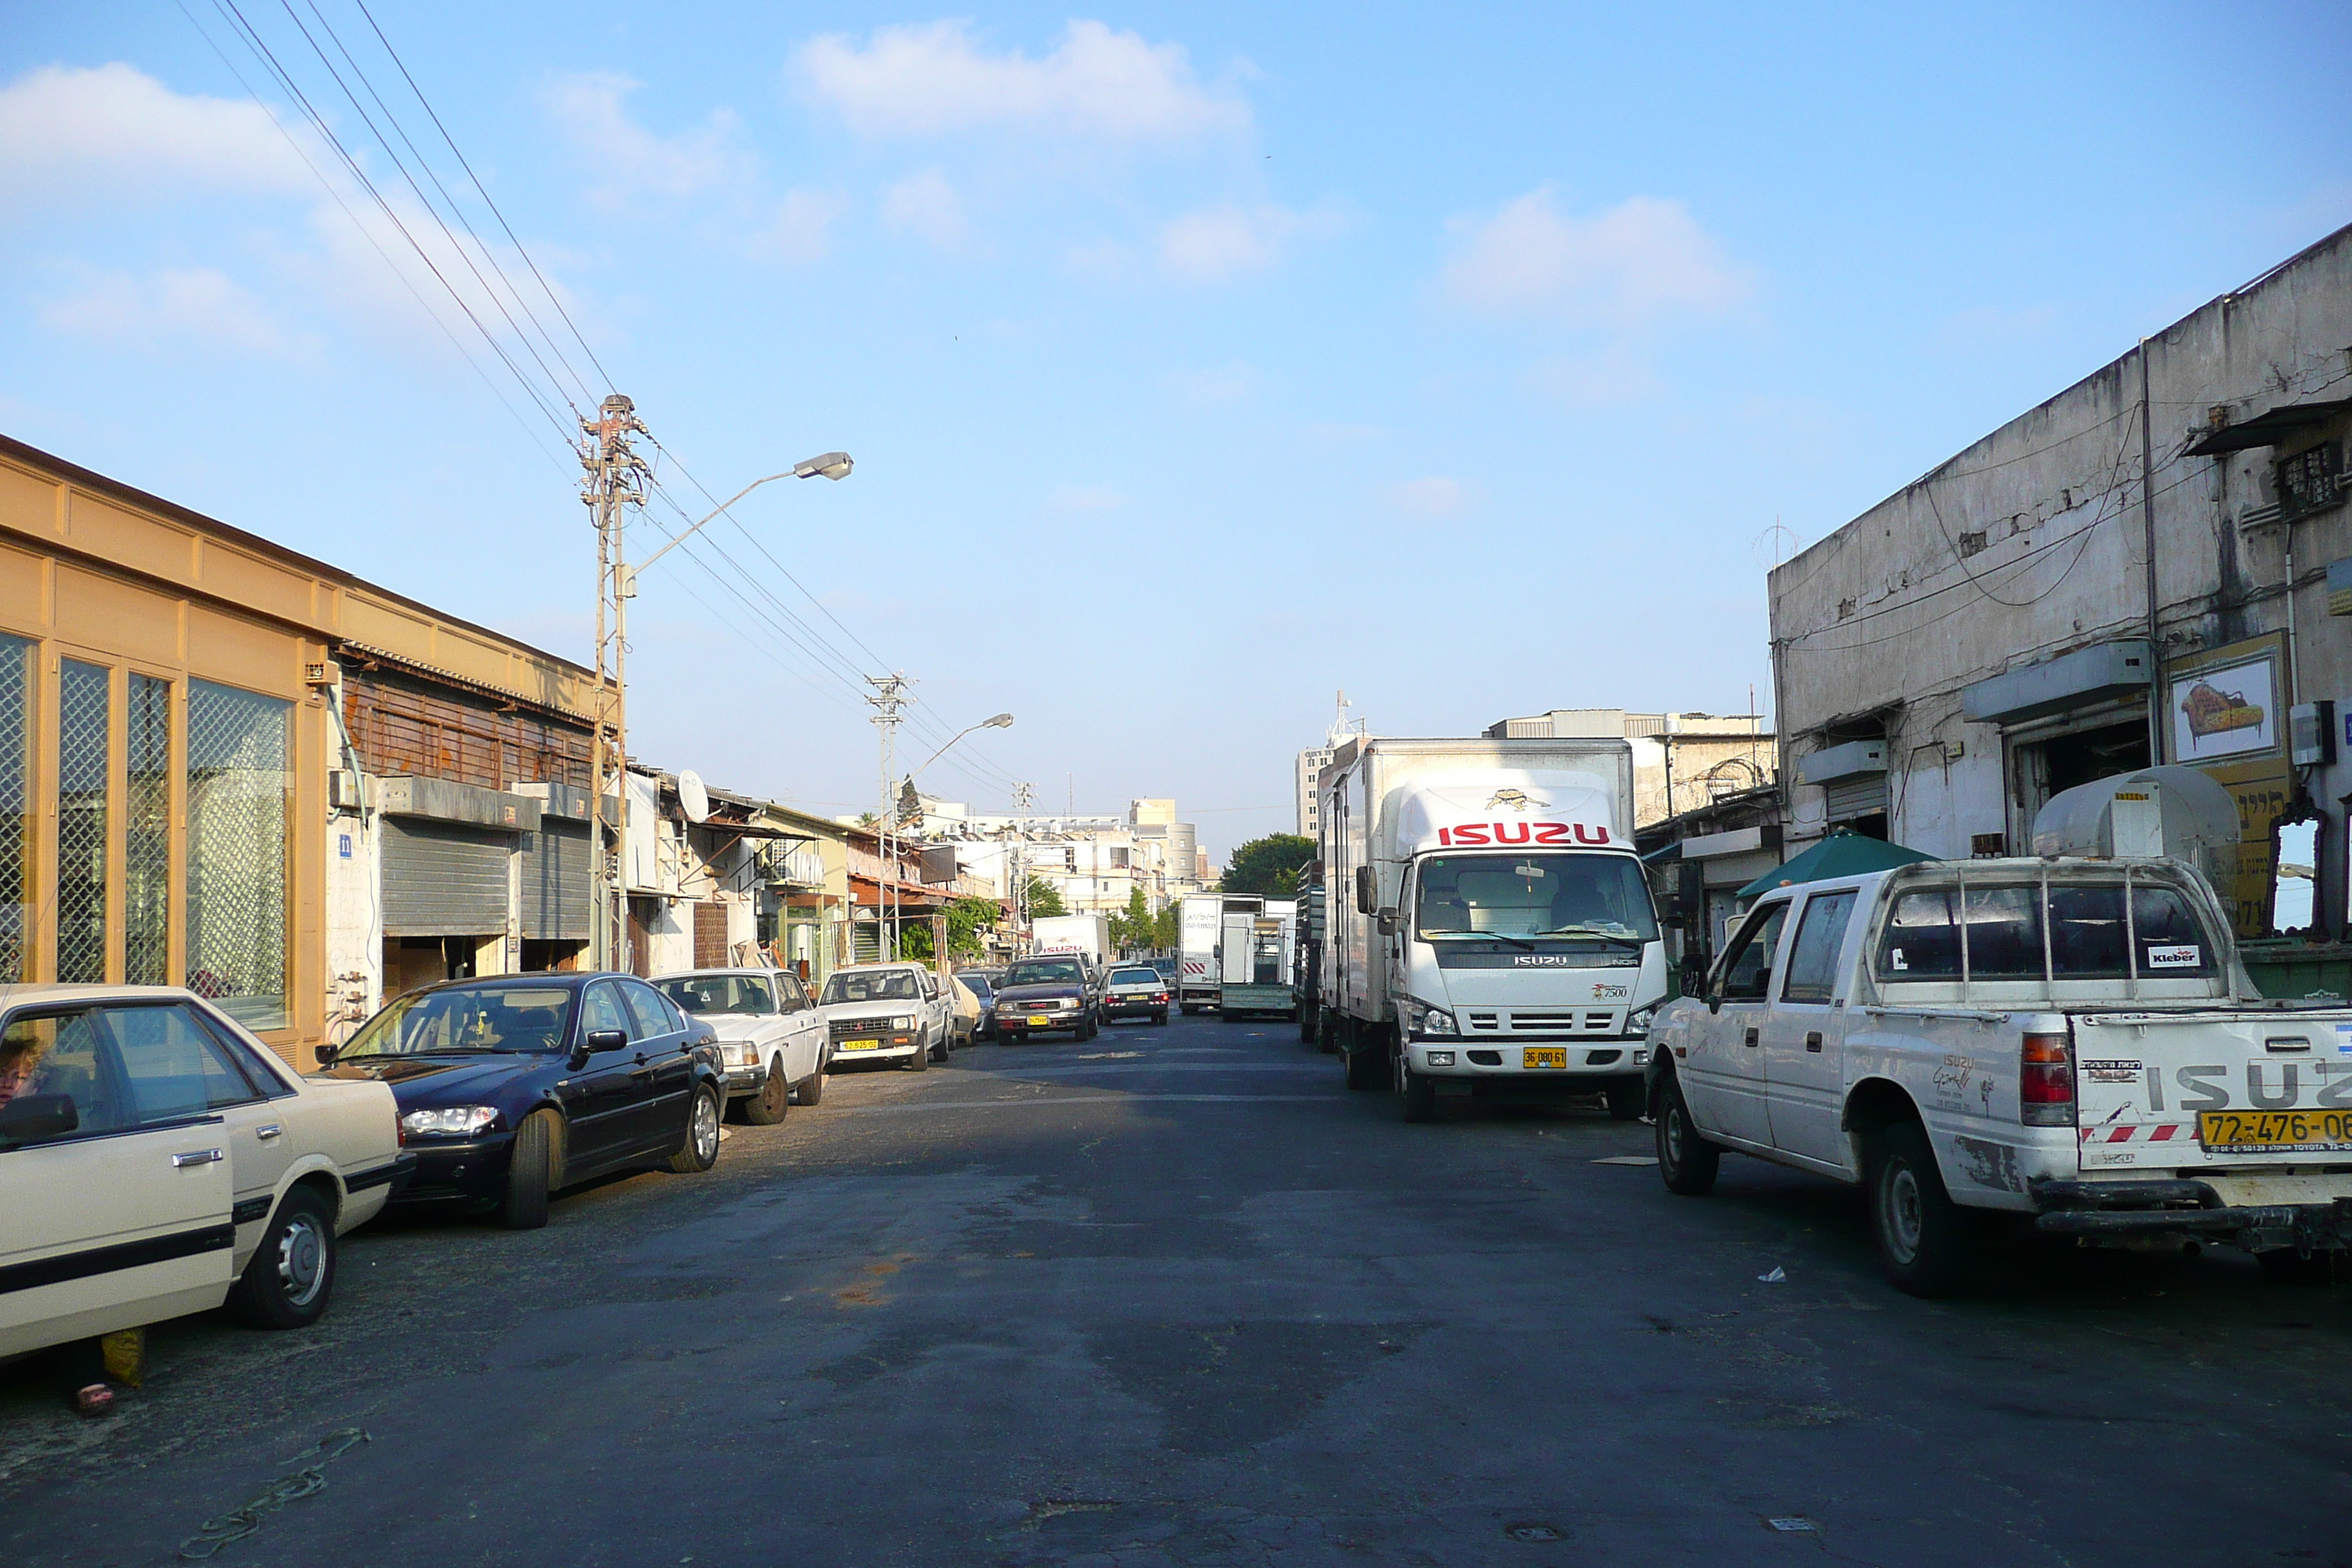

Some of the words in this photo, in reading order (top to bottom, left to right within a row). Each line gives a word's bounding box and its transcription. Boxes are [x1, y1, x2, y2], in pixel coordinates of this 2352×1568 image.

[1439, 822, 1610, 845] ISUZU
[342, 840, 350, 853] 11
[1043, 945, 1082, 953] ISUZU
[1514, 956, 1568, 966] ISUZU
[2153, 952, 2195, 962] Kleber
[1605, 988, 1627, 998] 7500
[1944, 1054, 1974, 1069] ISUZU
